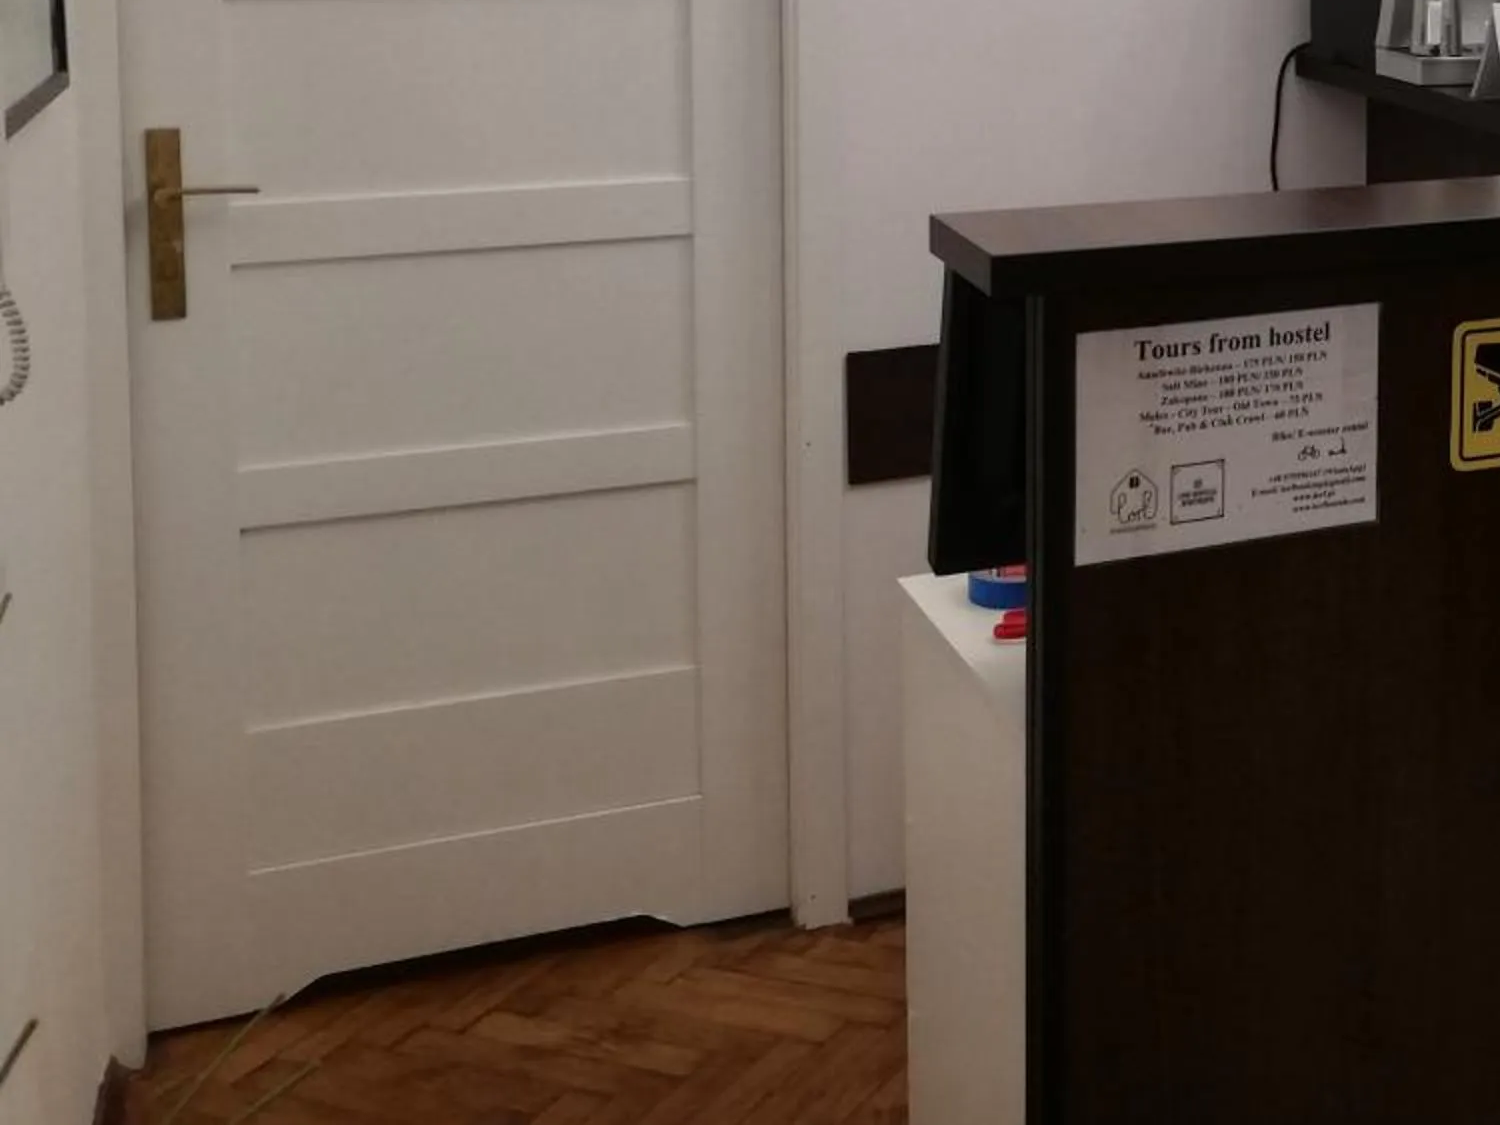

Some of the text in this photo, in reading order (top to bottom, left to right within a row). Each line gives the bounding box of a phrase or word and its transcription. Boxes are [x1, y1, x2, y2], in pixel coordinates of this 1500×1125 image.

[1134, 321, 1330, 361] Tours from hostel
